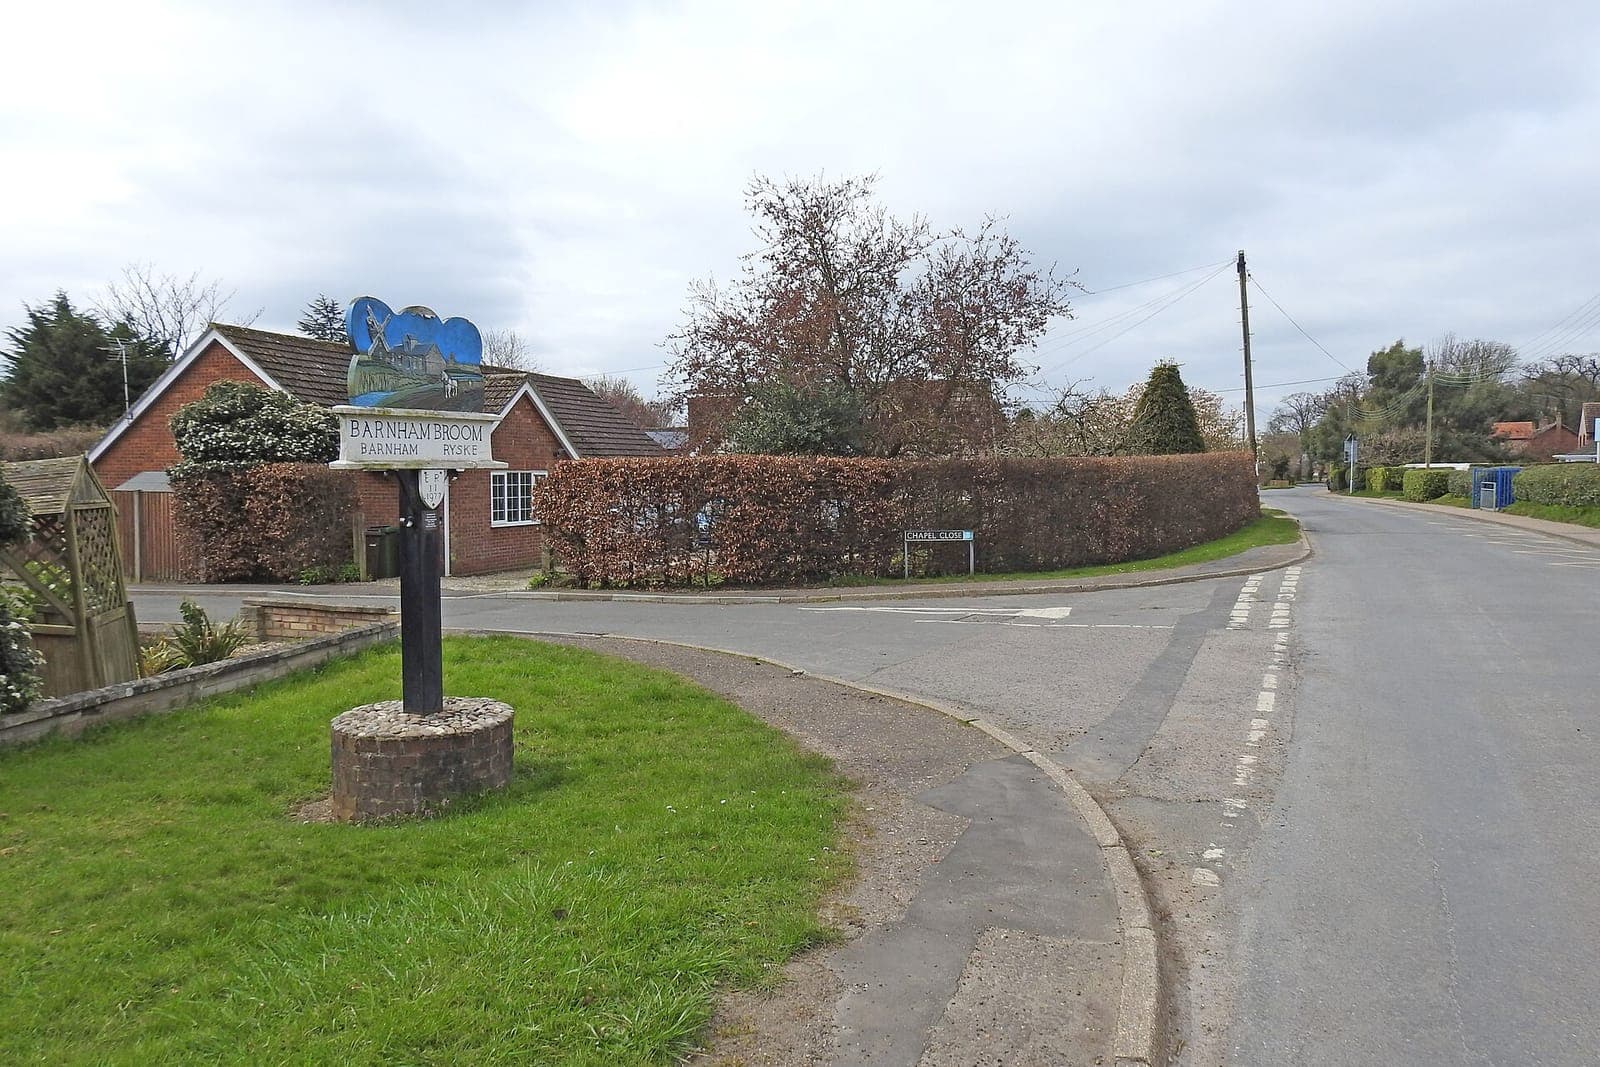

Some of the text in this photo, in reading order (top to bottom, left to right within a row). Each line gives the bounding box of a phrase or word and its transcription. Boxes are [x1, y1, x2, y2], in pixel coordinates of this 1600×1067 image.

[350, 420, 482, 441] BARNHAM BROOM
[361, 442, 478, 456] BARNHAM RYSKE
